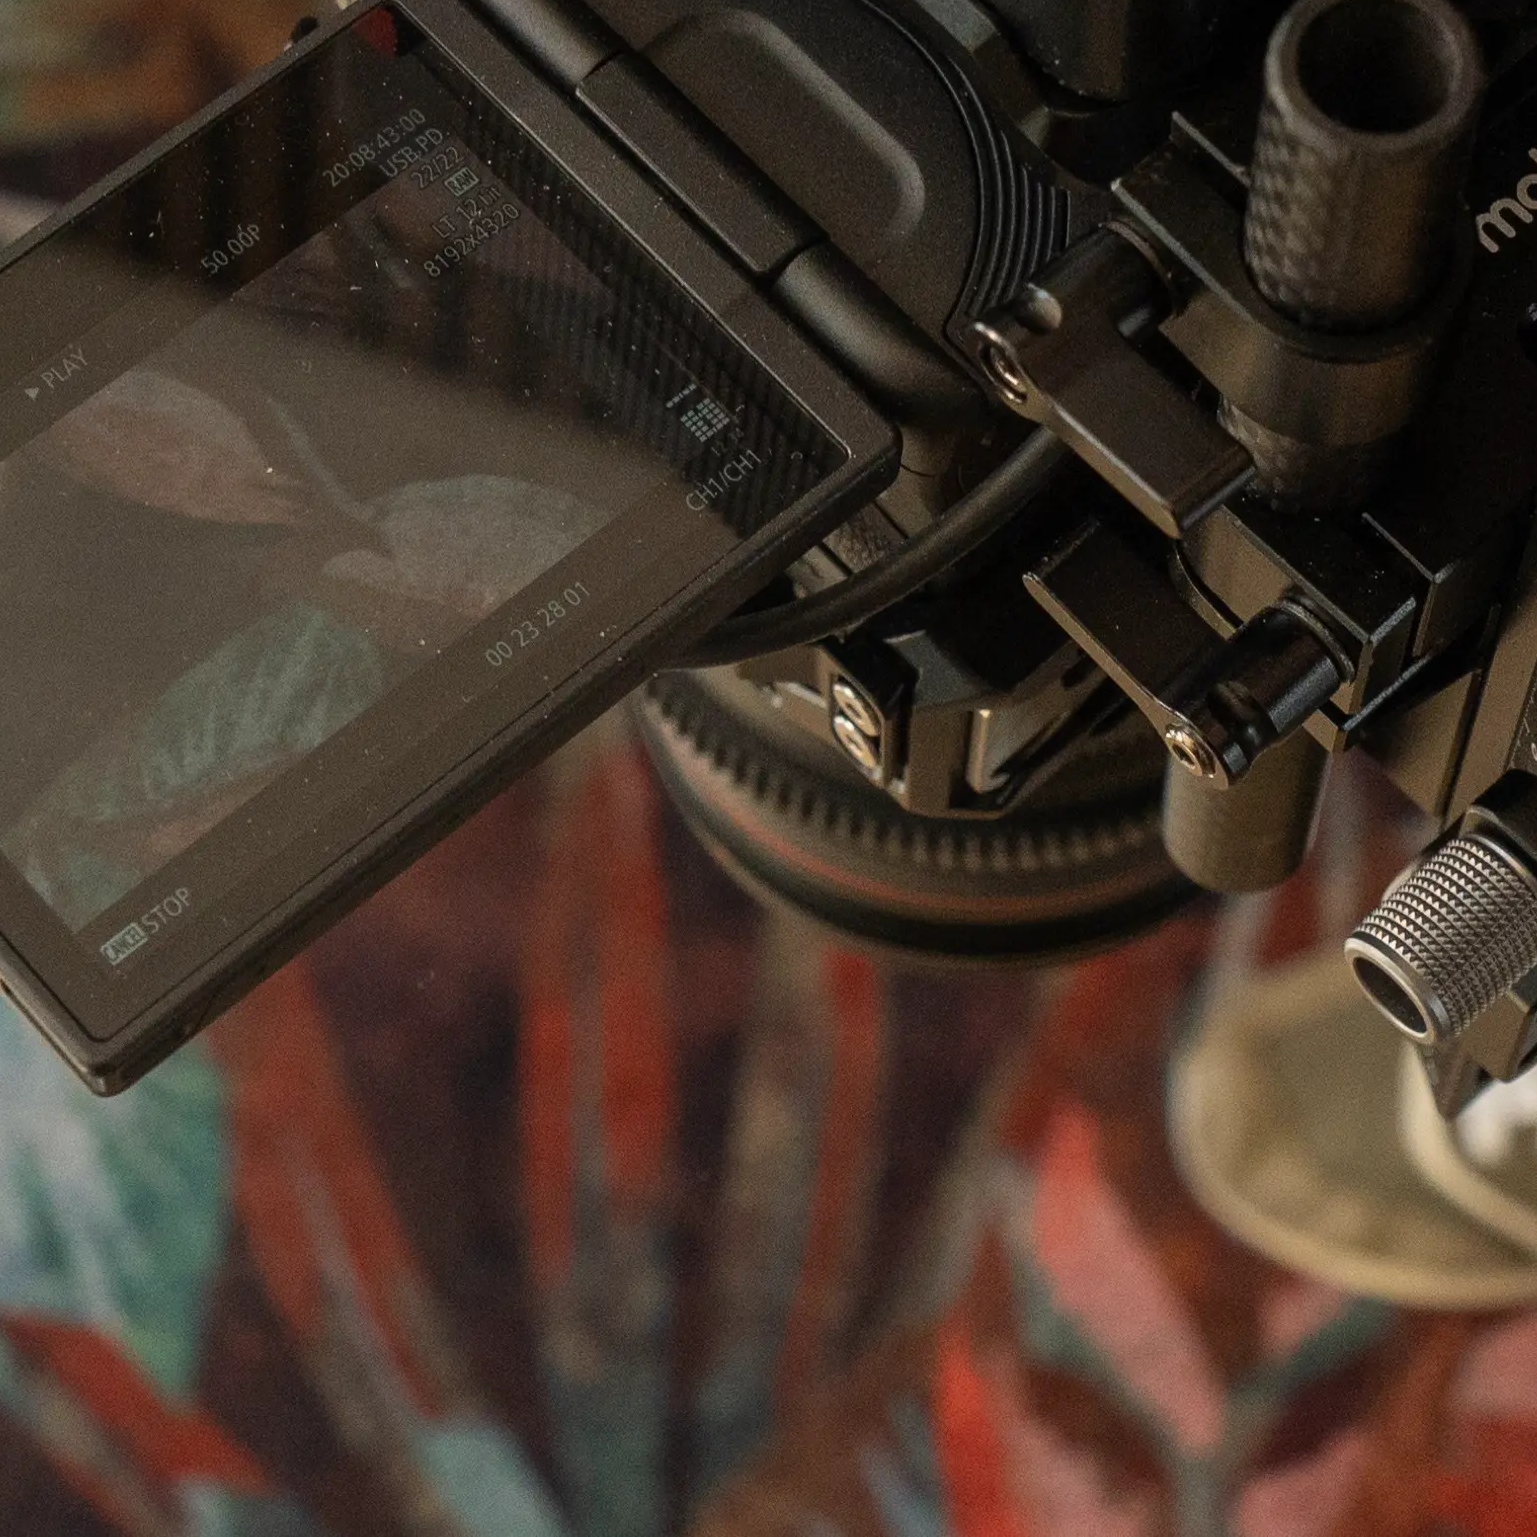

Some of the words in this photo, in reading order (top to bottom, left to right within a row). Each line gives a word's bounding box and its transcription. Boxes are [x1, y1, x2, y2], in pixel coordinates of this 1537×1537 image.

[322, 107, 425, 188] 20:08:43:00
[410, 146, 464, 190] 22/22
[446, 168, 477, 195] RAW
[200, 224, 260, 275] 50.00P
[423, 203, 521, 277] 8192x4320
[432, 215, 457, 239] LT
[41, 348, 88, 389] PLAY
[141, 887, 190, 934] STOP
